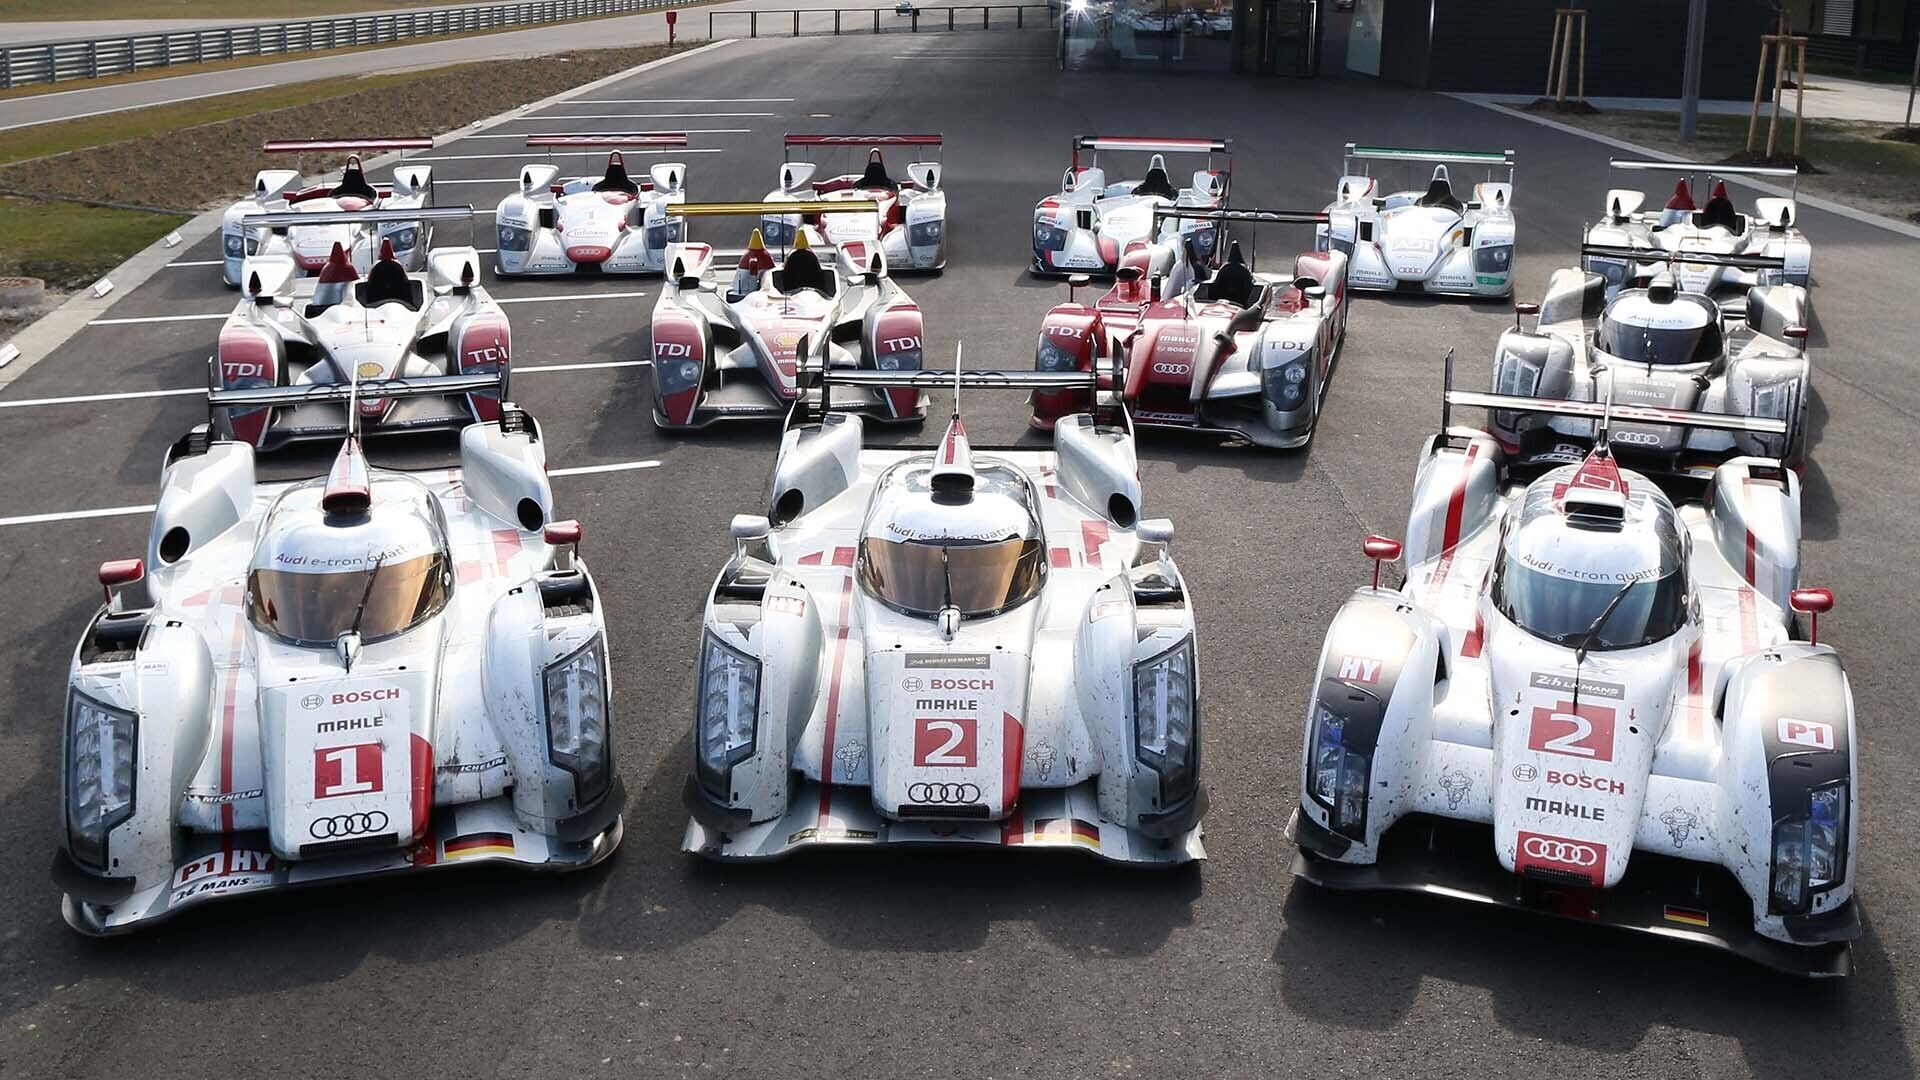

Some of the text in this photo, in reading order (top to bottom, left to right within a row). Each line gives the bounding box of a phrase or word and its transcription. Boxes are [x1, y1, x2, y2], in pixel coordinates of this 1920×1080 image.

[1047, 325, 1084, 339] TDI
[1160, 335, 1196, 343] MAHLE
[655, 342, 692, 358] TDI
[883, 335, 922, 351] TDI
[1268, 340, 1306, 351] TDI
[467, 346, 508, 364] TDI
[223, 362, 264, 377] TDI
[1626, 390, 1665, 399] MAHLE
[887, 522, 916, 538] Audi
[275, 552, 308, 566] Audi
[310, 555, 363, 567] e-tron
[1522, 553, 1665, 583] Audi e-tron quattro
[1338, 656, 1383, 682] HY
[931, 679, 994, 690] BOSCH
[1581, 684, 1620, 696] MANS
[332, 688, 400, 705] BOSCH
[916, 699, 978, 711] MAHLE
[317, 716, 384, 734] MAHLE
[1787, 722, 1825, 744] P1
[925, 720, 966, 765] 2
[1544, 712, 1595, 757] 2
[325, 747, 373, 796] 1
[452, 757, 505, 773] ICHELIN
[1546, 770, 1626, 795] BOSCH
[202, 789, 262, 803] MICHELIN
[1525, 797, 1606, 822] MAHLE
[181, 849, 273, 882] P1 HY
[200, 877, 251, 892] MANS
